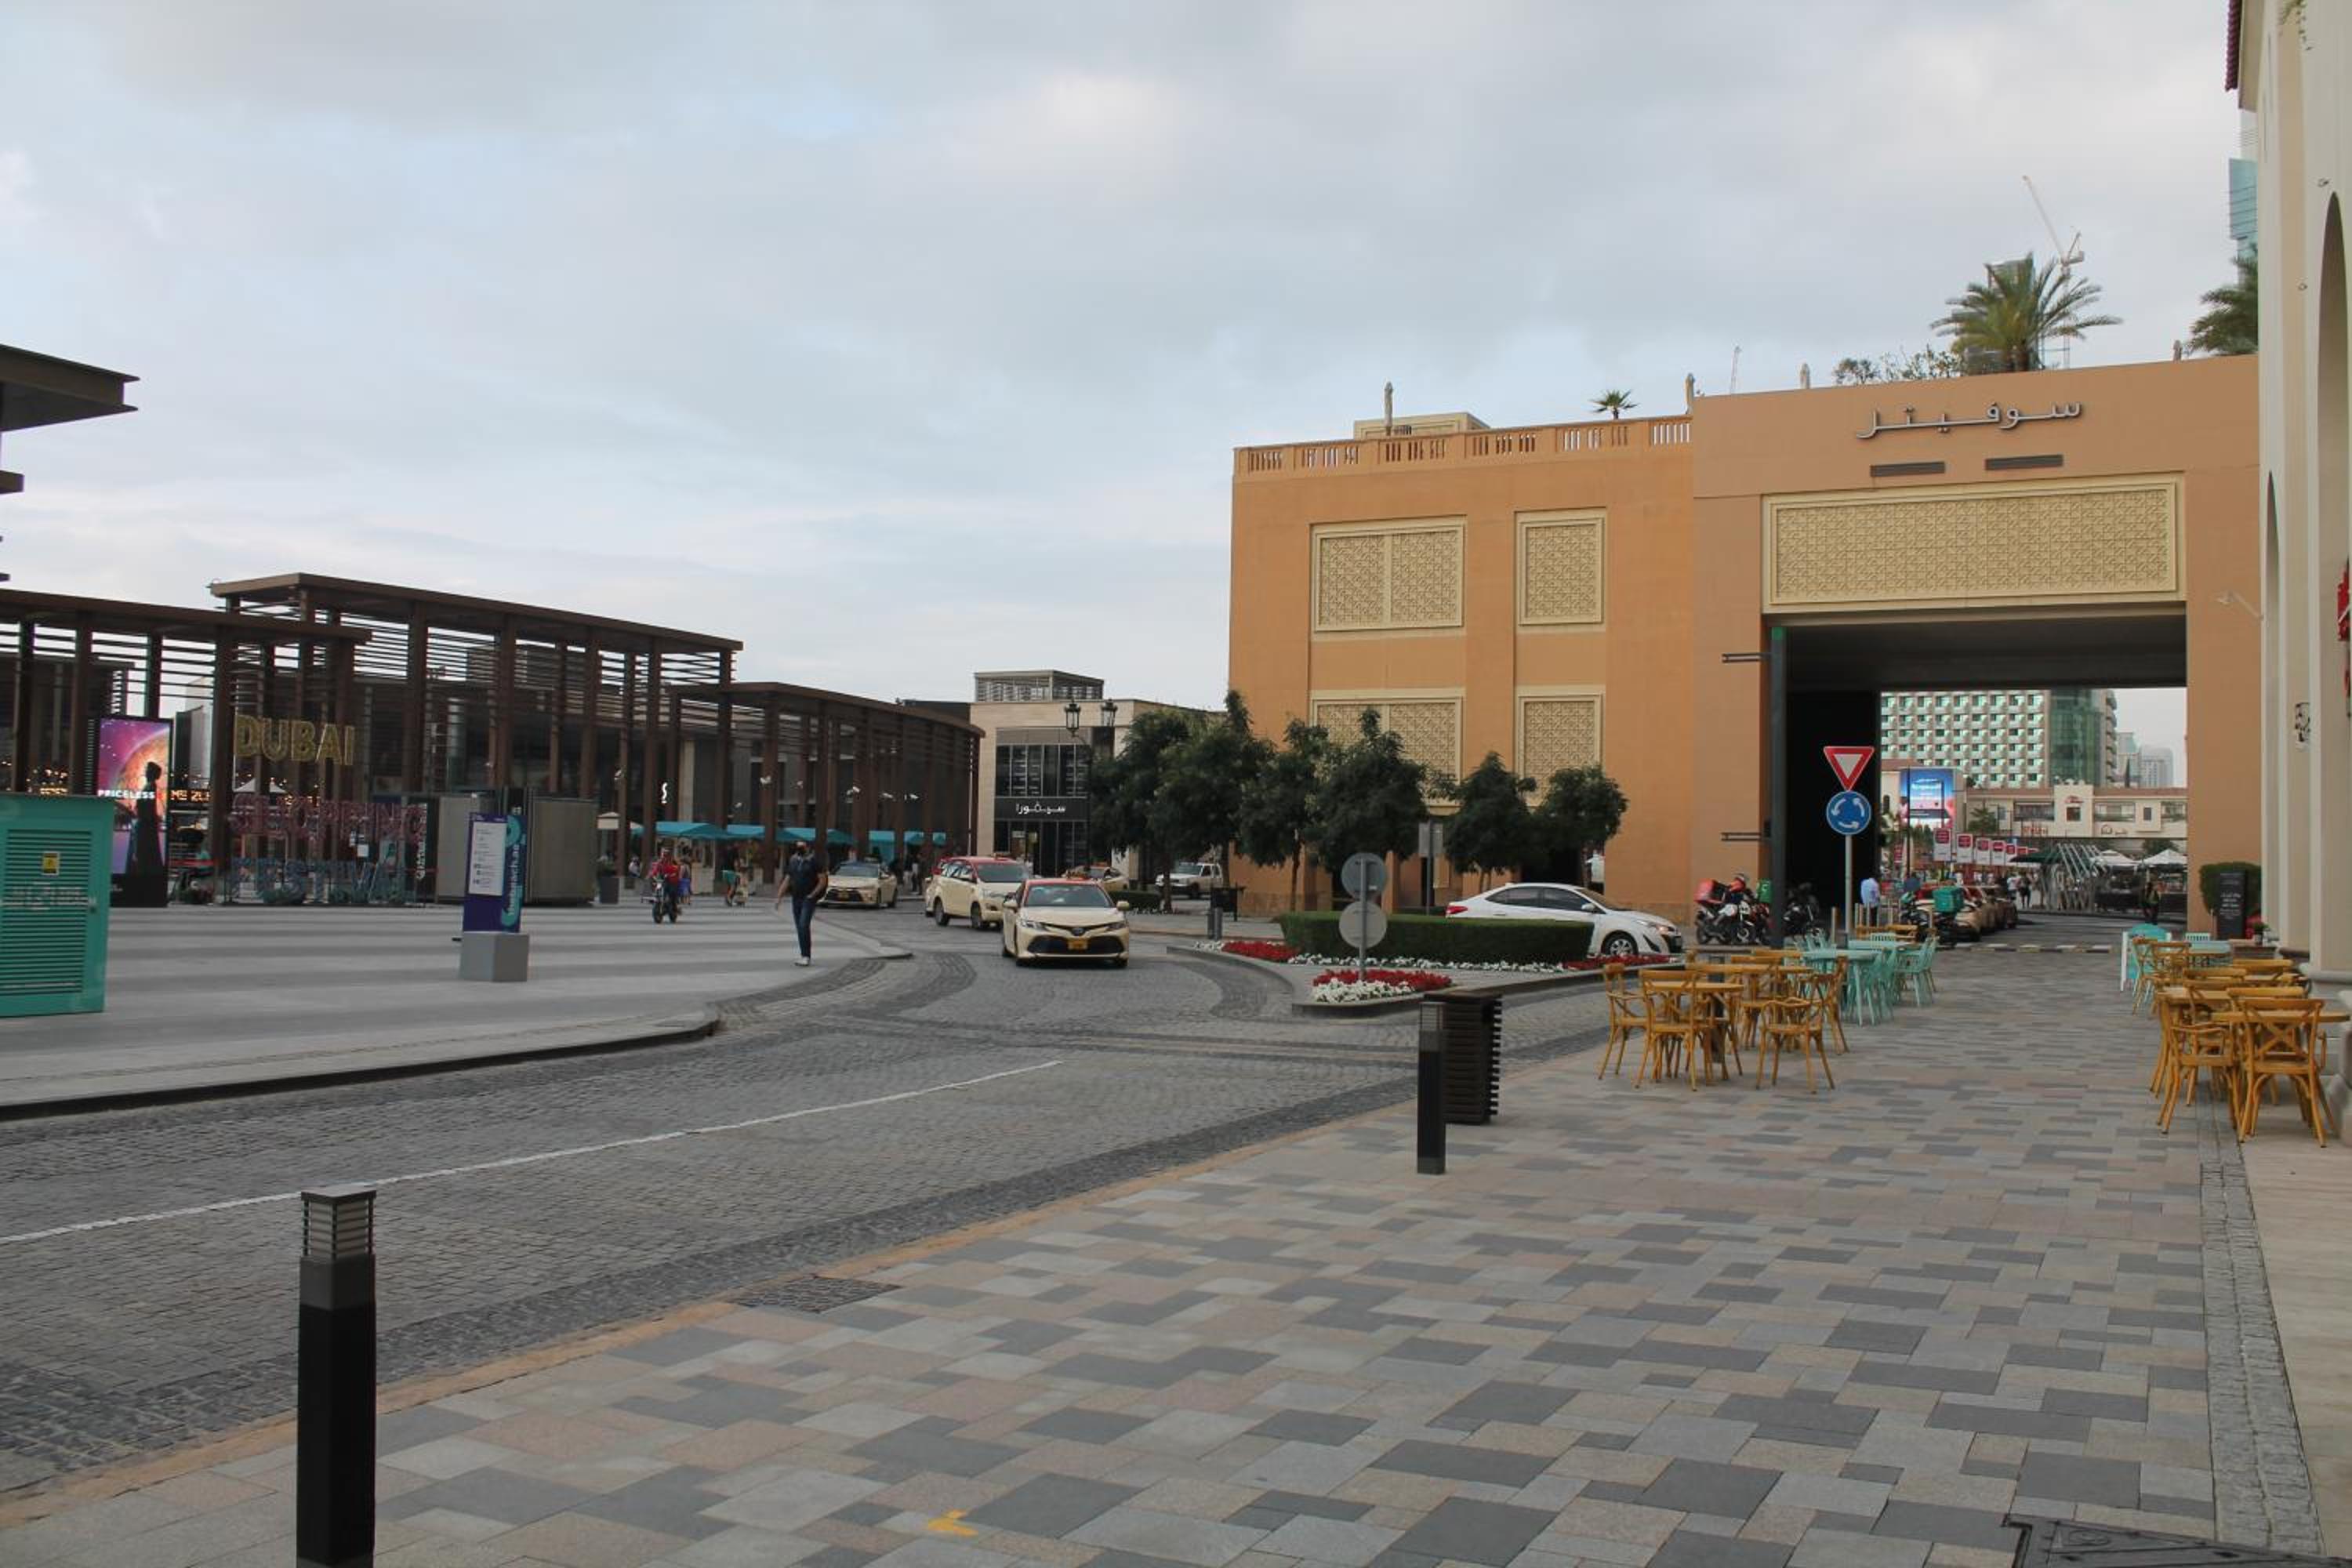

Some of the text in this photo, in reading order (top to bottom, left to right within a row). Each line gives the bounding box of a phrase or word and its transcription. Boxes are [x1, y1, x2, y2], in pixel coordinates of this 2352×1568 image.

[1856, 401, 2082, 439] سوفيتل
[234, 714, 356, 766] DUBAI
[97, 789, 155, 800] PRICELESS
